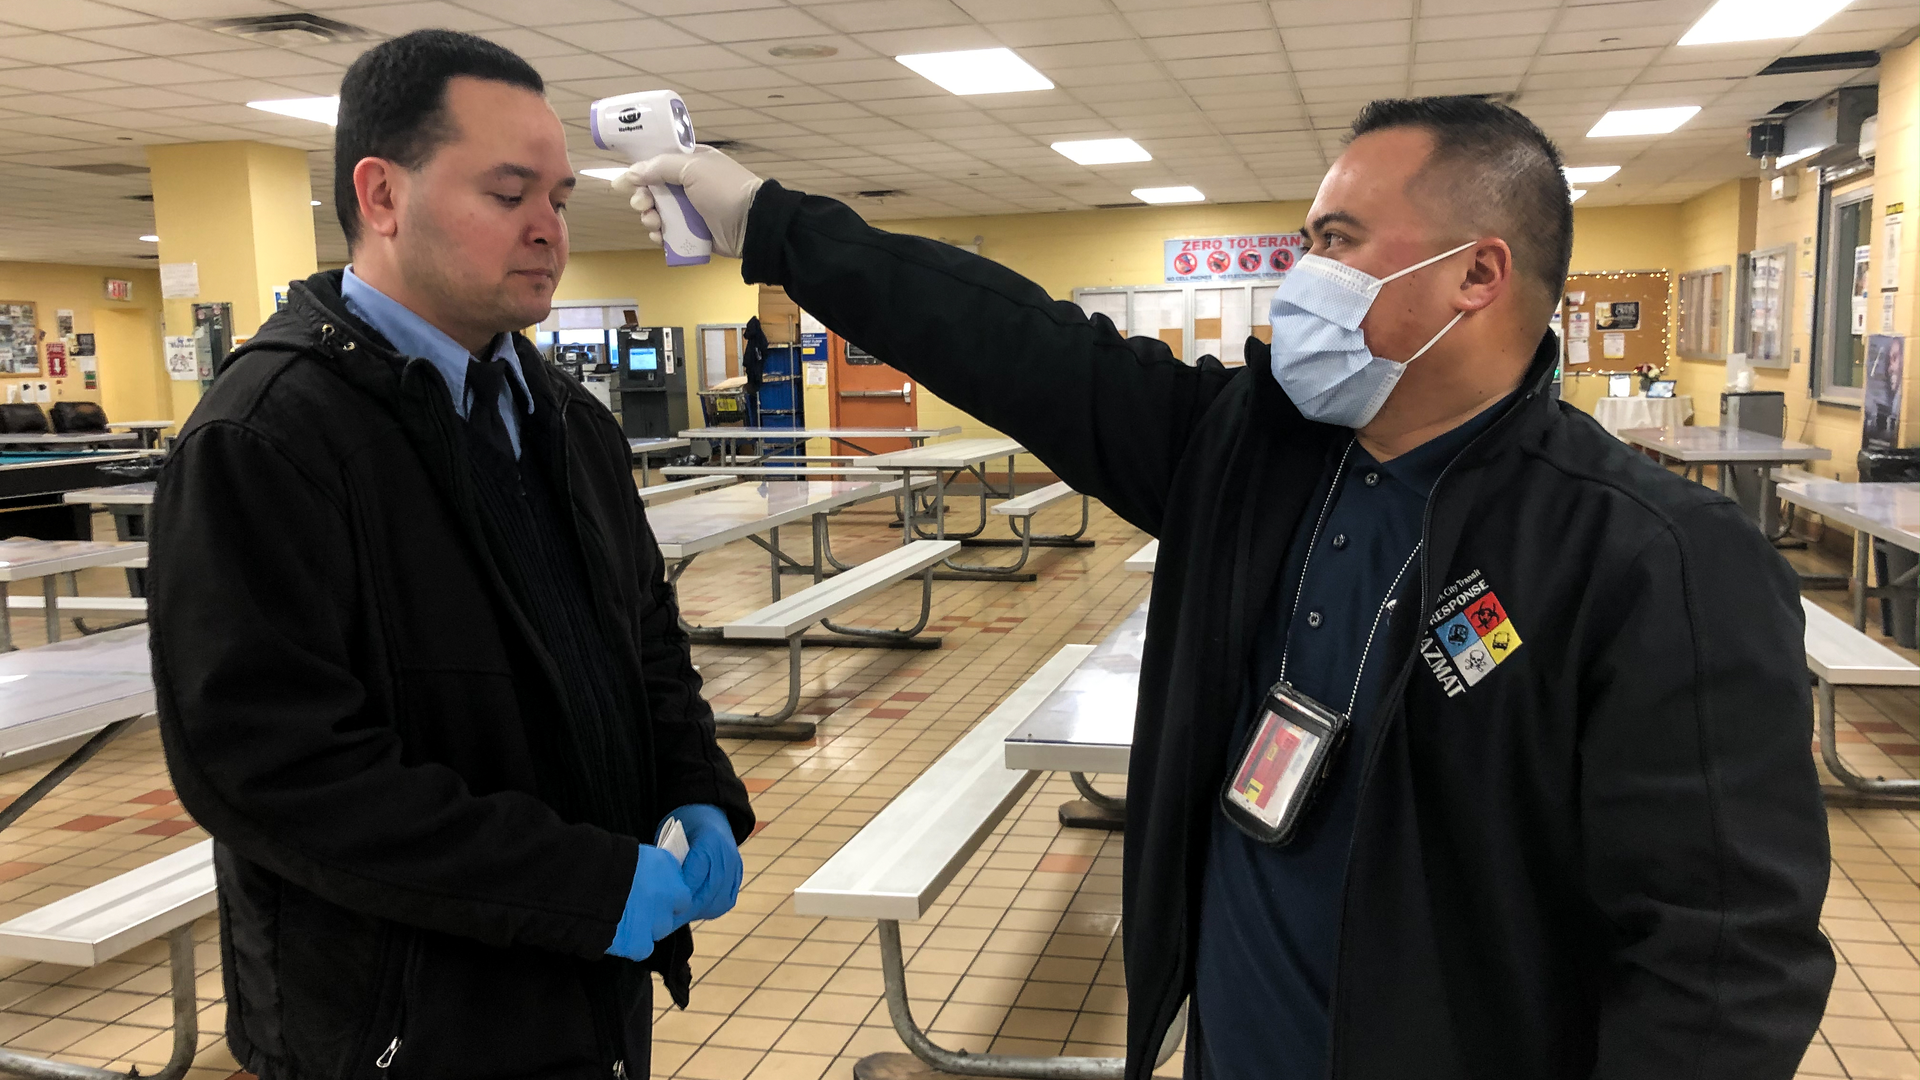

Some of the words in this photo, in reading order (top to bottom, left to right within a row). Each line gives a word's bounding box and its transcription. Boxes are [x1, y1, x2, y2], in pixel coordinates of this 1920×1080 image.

[1182, 239, 1222, 252] ZERO
[112, 281, 128, 297] EXIT
[1443, 586, 1458, 597] City
[1456, 568, 1481, 588] Transit
[1420, 636, 1467, 698] AZMAT
